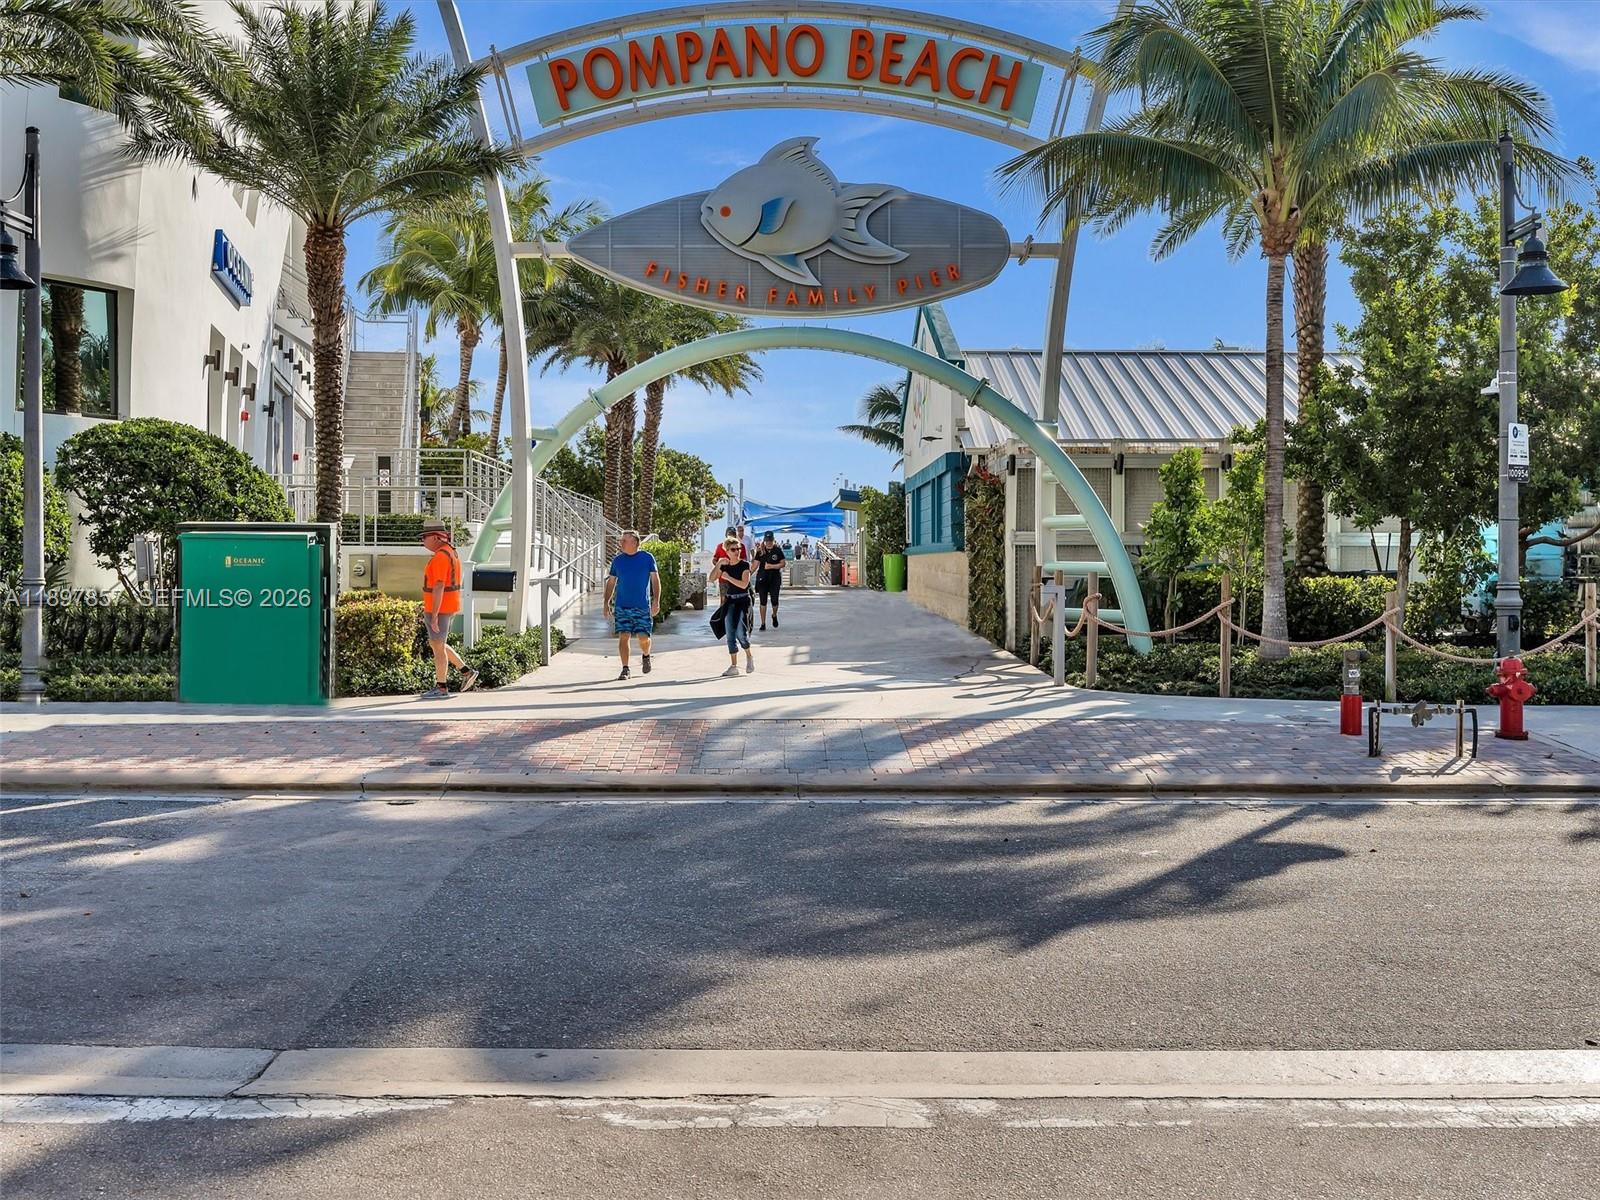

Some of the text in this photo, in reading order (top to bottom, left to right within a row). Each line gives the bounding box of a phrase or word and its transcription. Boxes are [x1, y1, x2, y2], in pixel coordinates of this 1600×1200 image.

[548, 24, 1022, 111] POMPANO BEACH
[644, 260, 960, 306] FISHER FAMILY PIER
